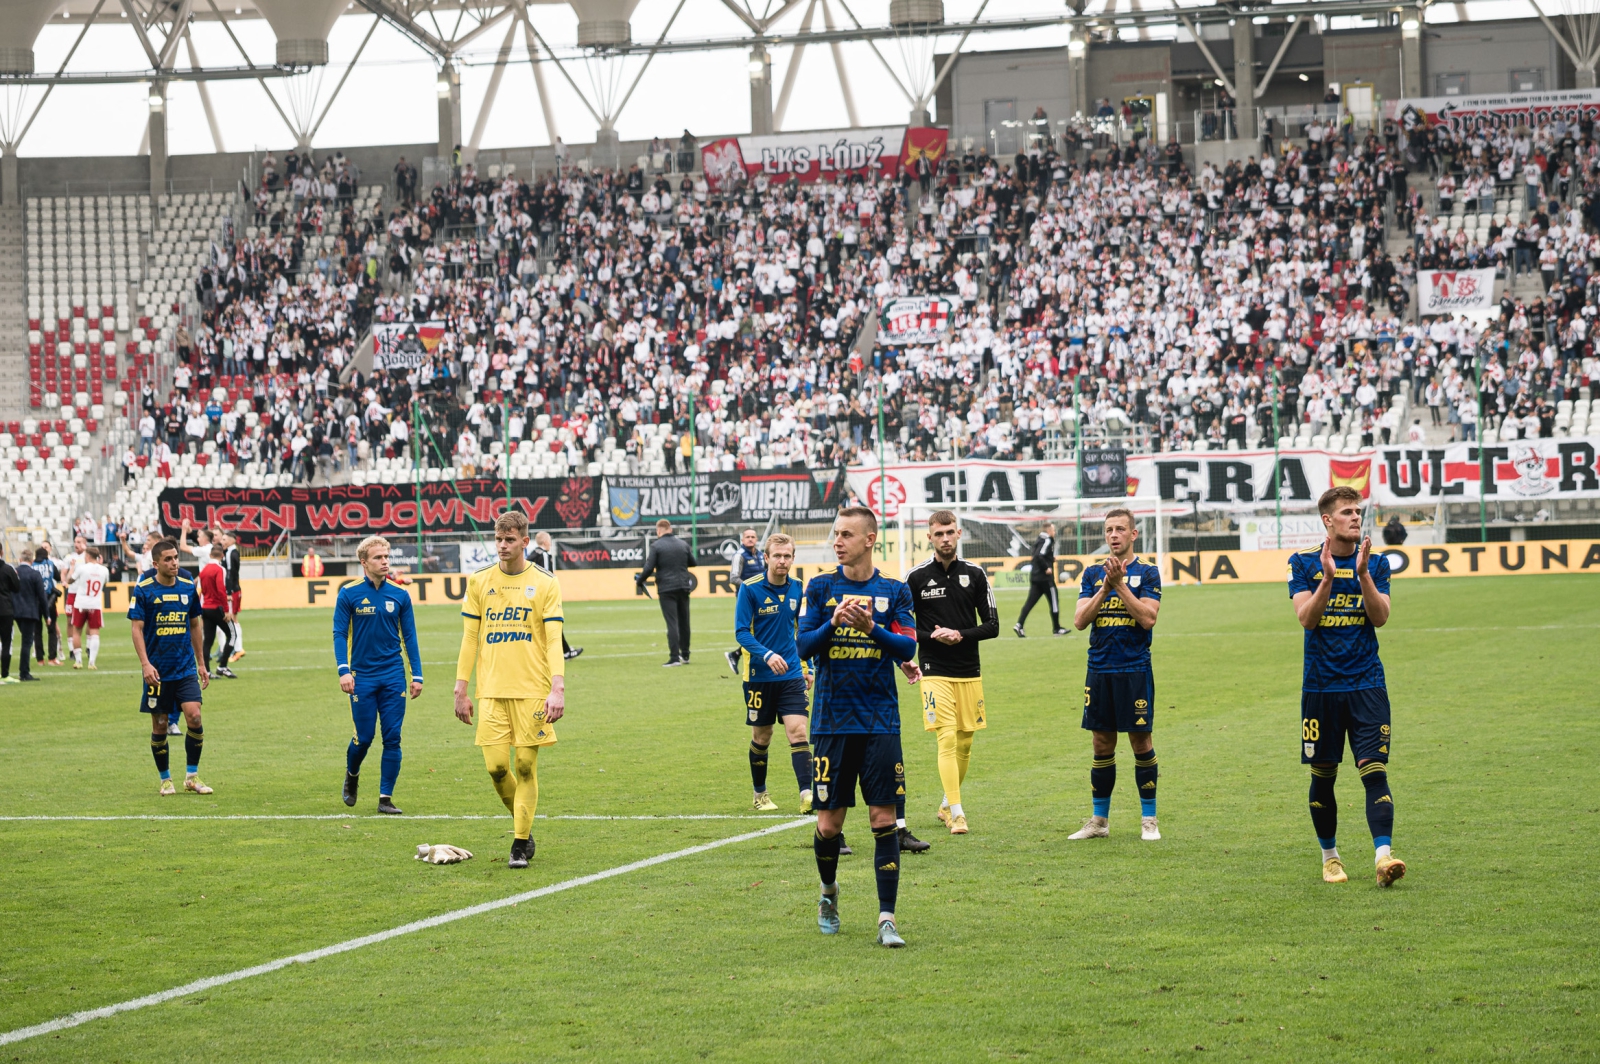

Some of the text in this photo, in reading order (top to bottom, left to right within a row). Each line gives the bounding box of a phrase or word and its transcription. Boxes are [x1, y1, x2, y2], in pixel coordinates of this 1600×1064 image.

[607, 477, 617, 486] W
[639, 485, 710, 515] ZAWSZE
[740, 481, 810, 510] WIERNI
[162, 496, 550, 531] ULICZNI WOJOWNICY
[561, 549, 610, 562] TOYOTA
[1385, 544, 1600, 574] ORTUNA
[86, 579, 102, 597] 19
[921, 588, 946, 598] forBET
[486, 607, 533, 621] forBET
[758, 604, 780, 614] forBET
[156, 612, 188, 622] forBET
[1096, 616, 1136, 627] GDYNIA
[156, 627, 187, 636] GDYNIA
[486, 632, 533, 644] GDYNIA
[829, 646, 882, 660] GDYNIA
[748, 690, 762, 708] 26
[1302, 717, 1320, 741] 68
[814, 756, 831, 782] 32
